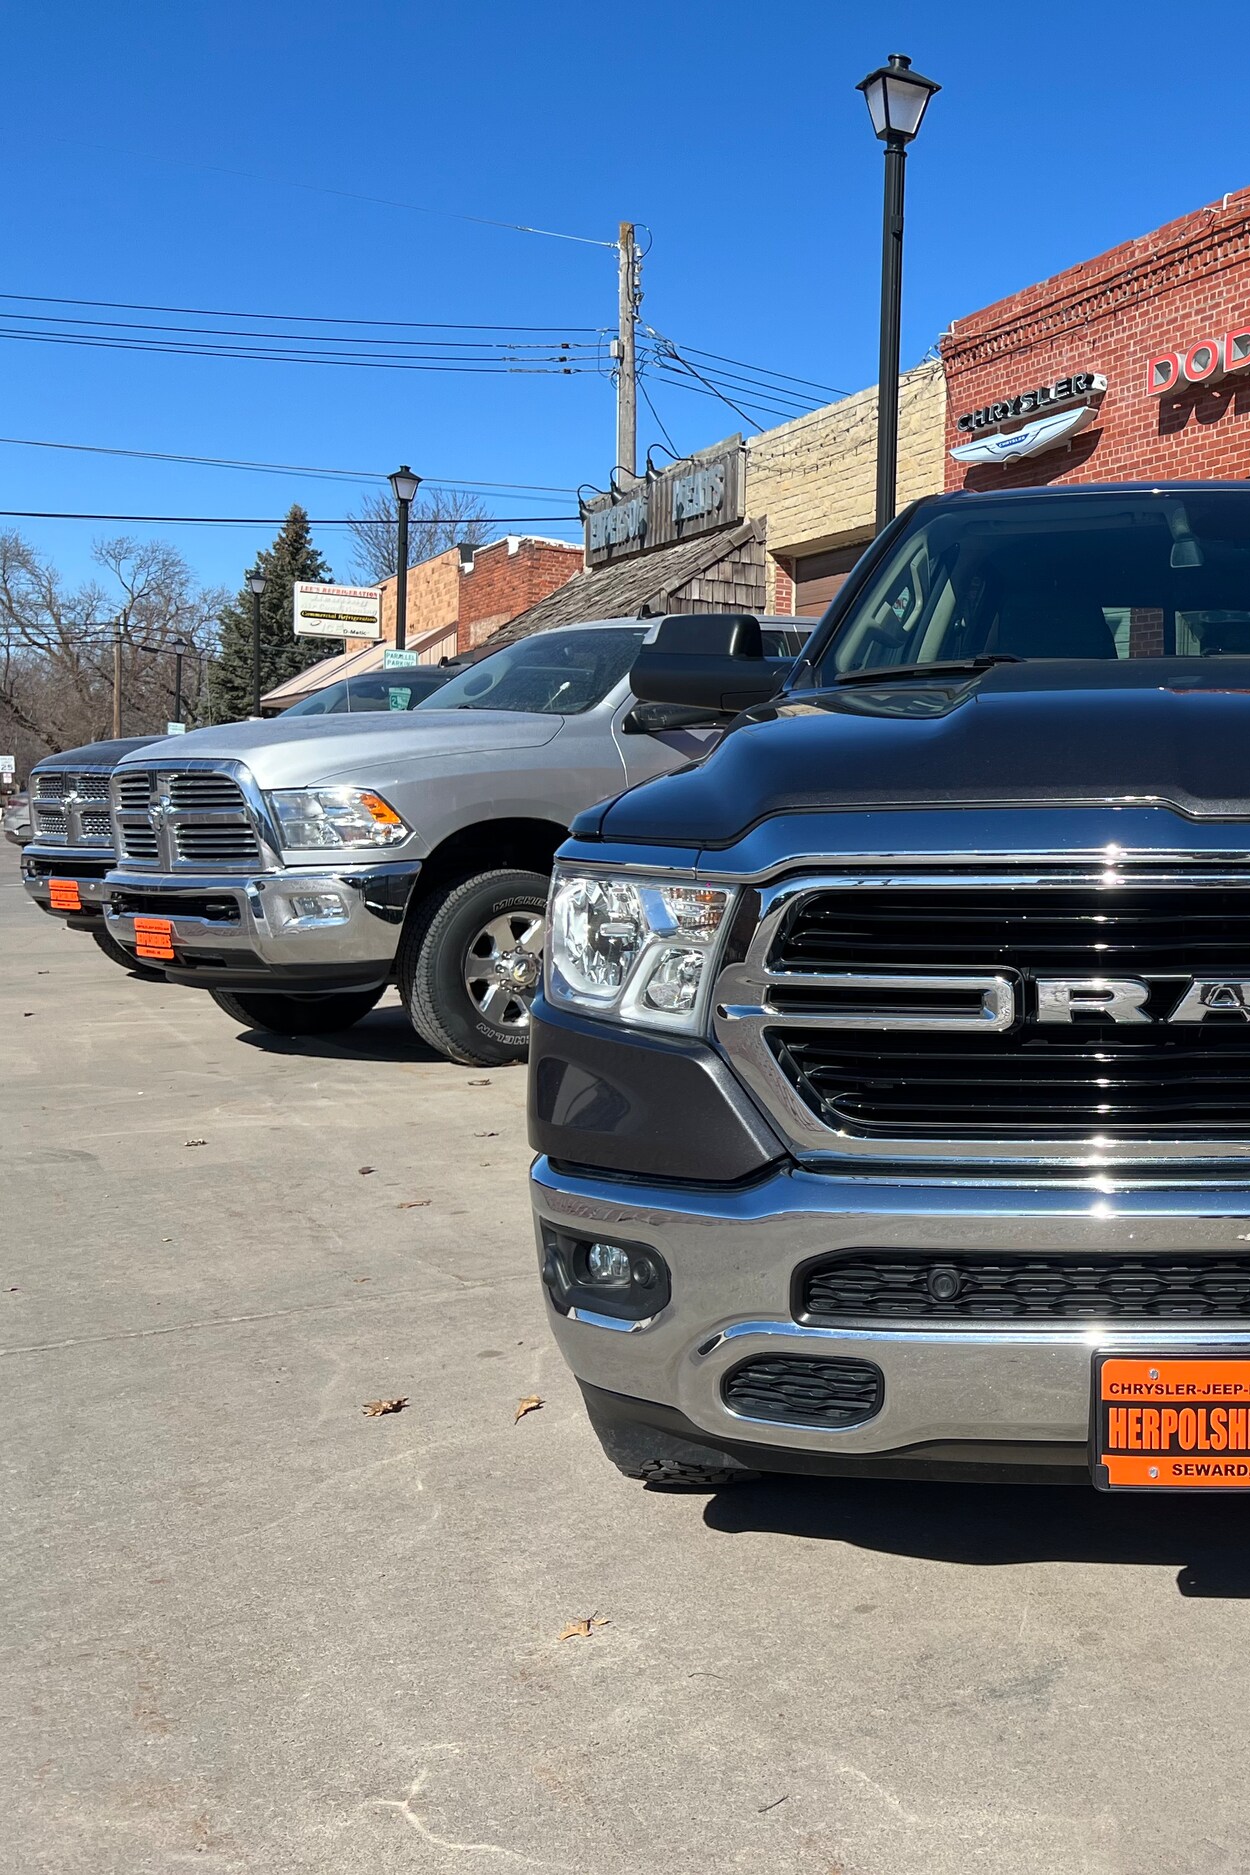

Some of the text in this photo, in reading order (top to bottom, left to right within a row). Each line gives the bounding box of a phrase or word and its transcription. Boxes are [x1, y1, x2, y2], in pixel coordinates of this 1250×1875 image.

[957, 372, 1091, 432] CHRYSLER
[386, 652, 415, 661] PARALLEL
[476, 1022, 530, 1045] HELIN
